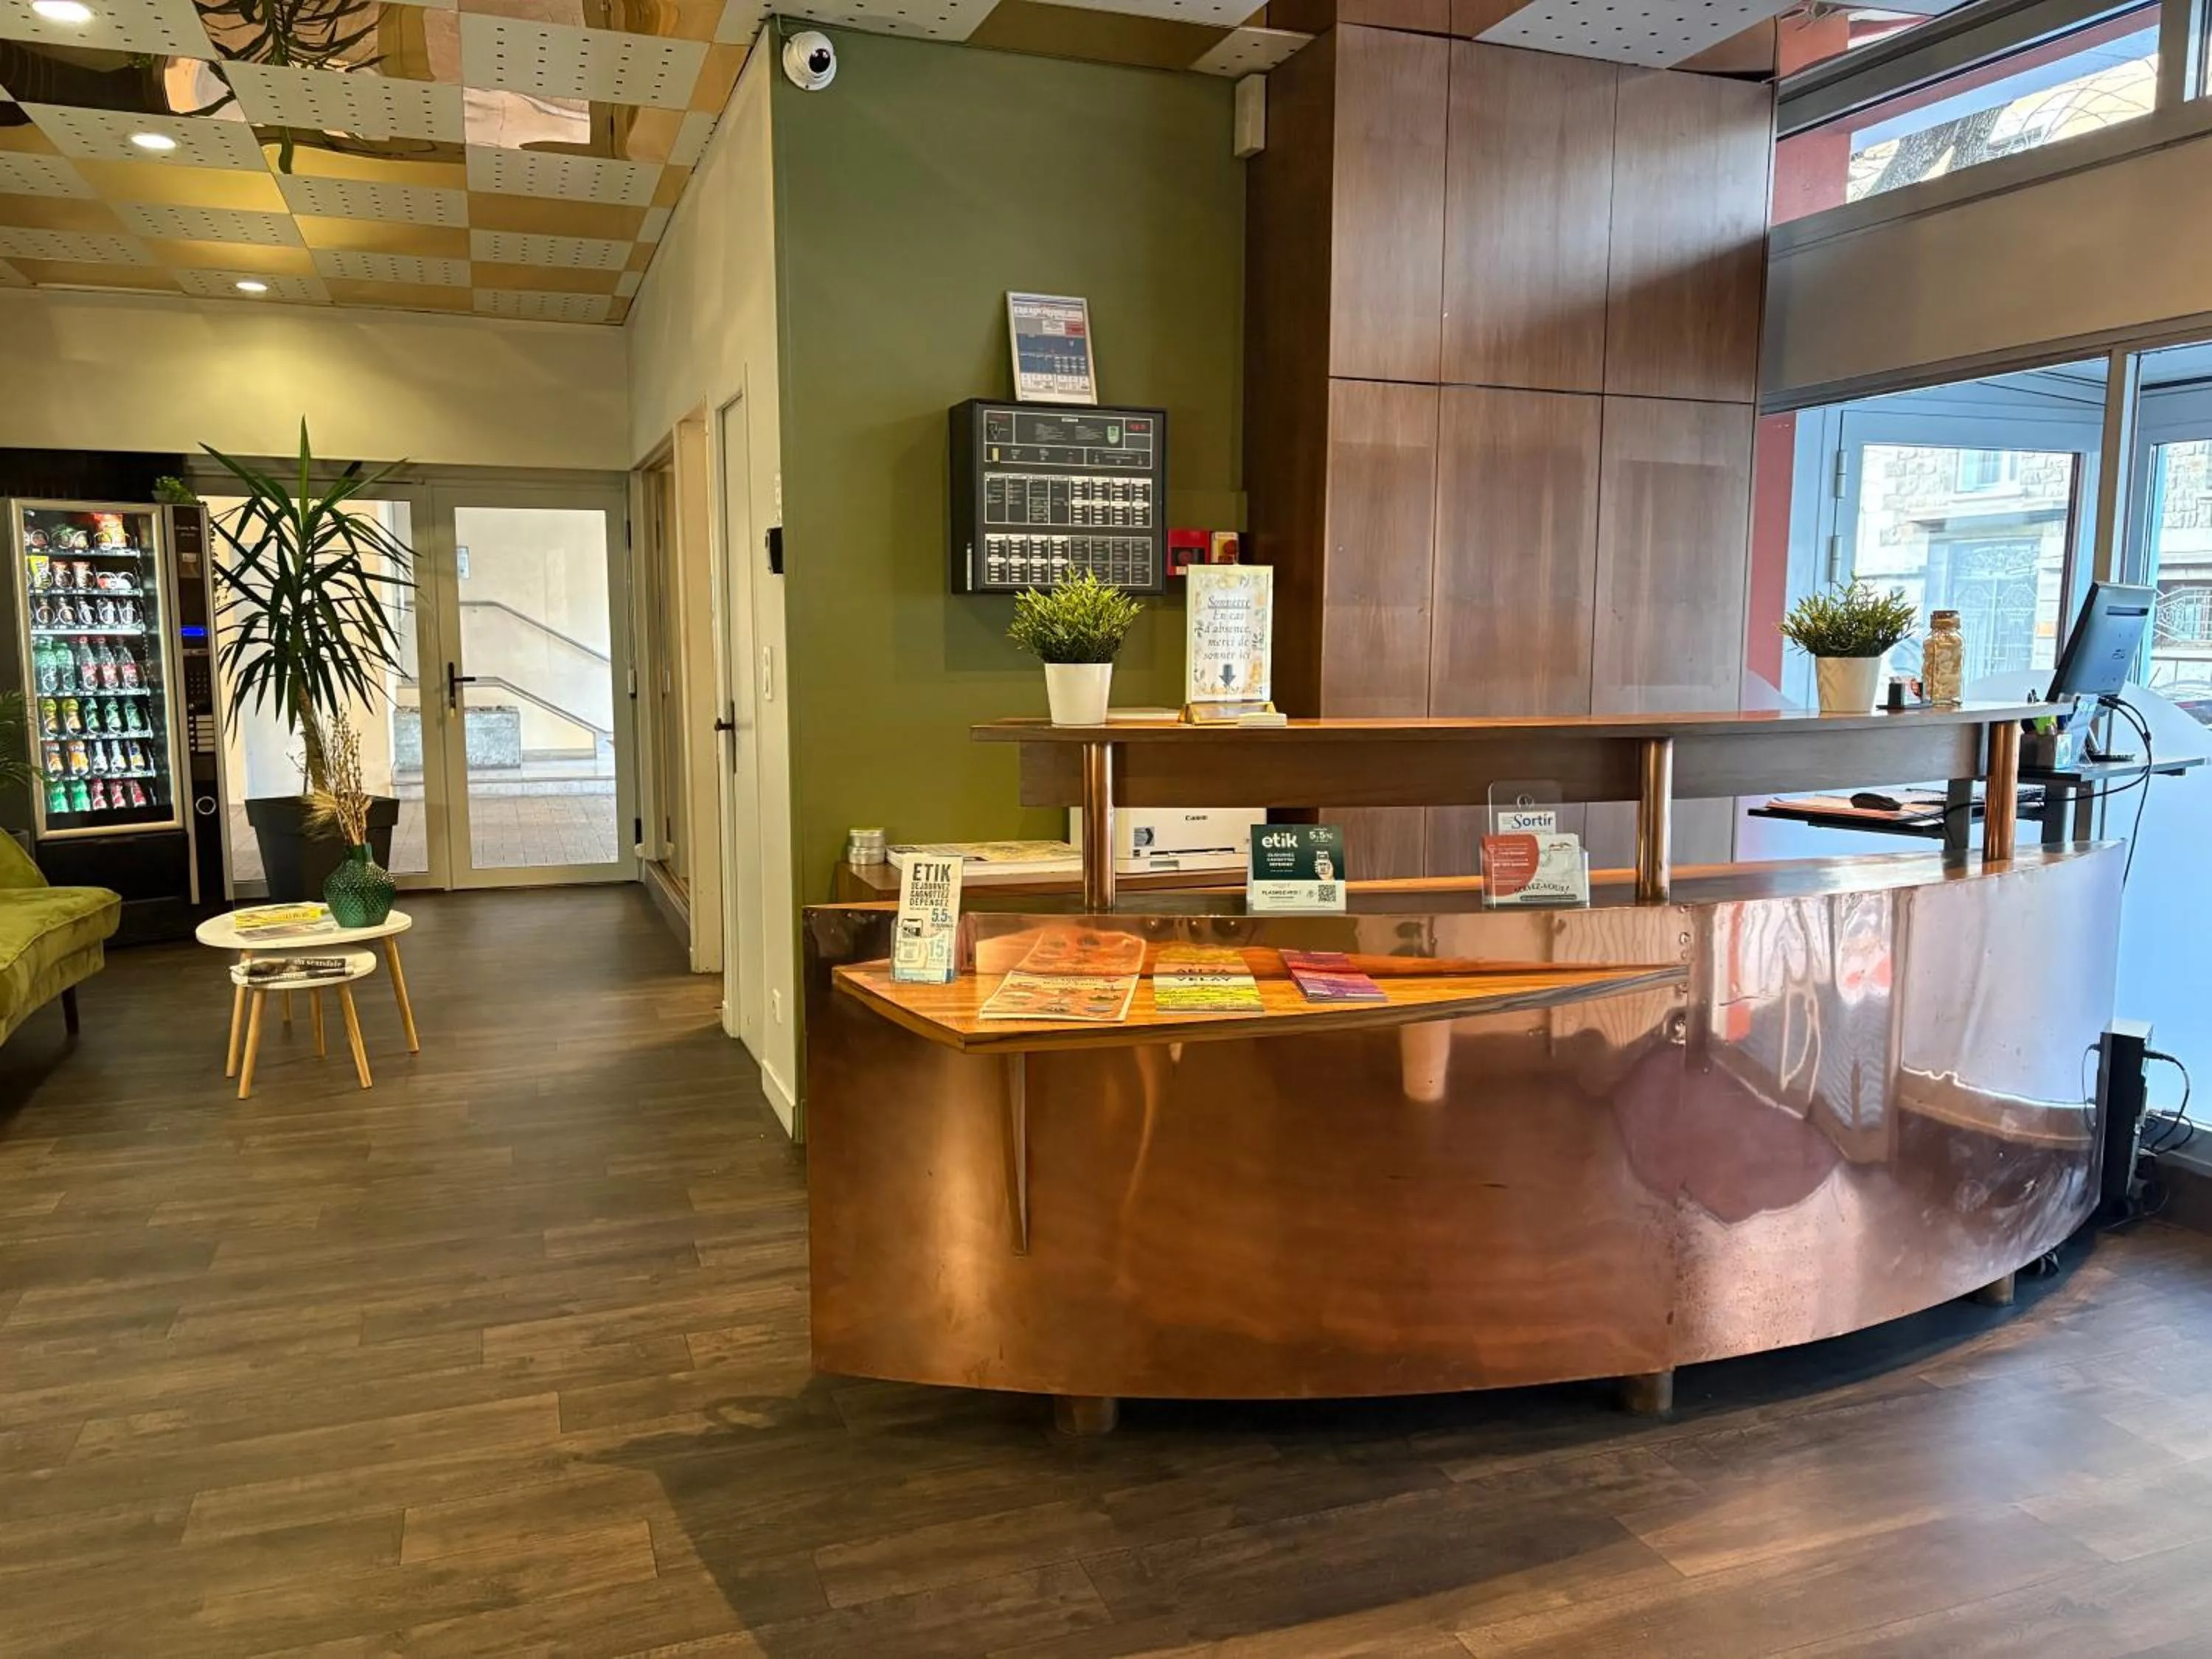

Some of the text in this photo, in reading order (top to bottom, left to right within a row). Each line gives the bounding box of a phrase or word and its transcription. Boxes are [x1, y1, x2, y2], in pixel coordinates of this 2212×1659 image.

[1207, 635, 1250, 647] merci de
[1512, 813, 1553, 830] Sortir
[1262, 832, 1298, 848] etik
[913, 863, 951, 882] ETIK
